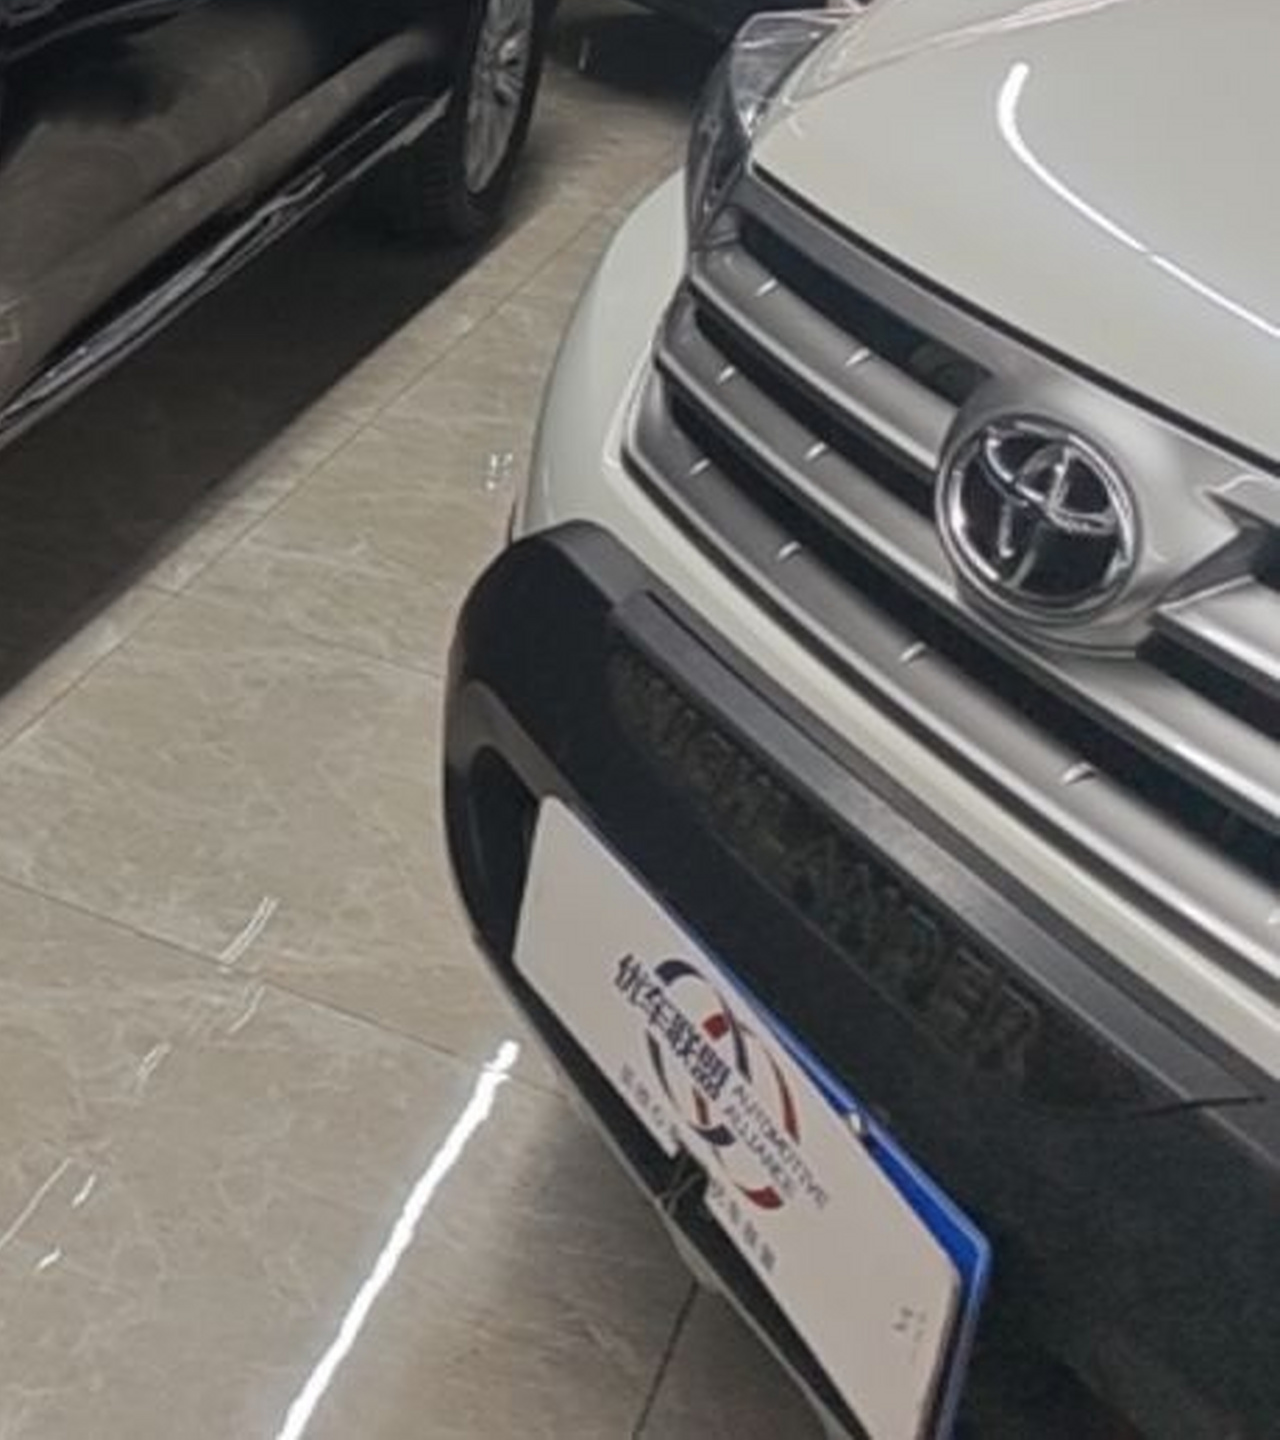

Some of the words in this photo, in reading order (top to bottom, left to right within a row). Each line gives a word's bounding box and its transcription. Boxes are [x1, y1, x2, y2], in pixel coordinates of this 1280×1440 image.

[614, 952, 731, 1101] 优车联盟
[721, 1101, 798, 1200] ALLIANCE
[731, 1084, 830, 1212] AUTOMOTIVE
